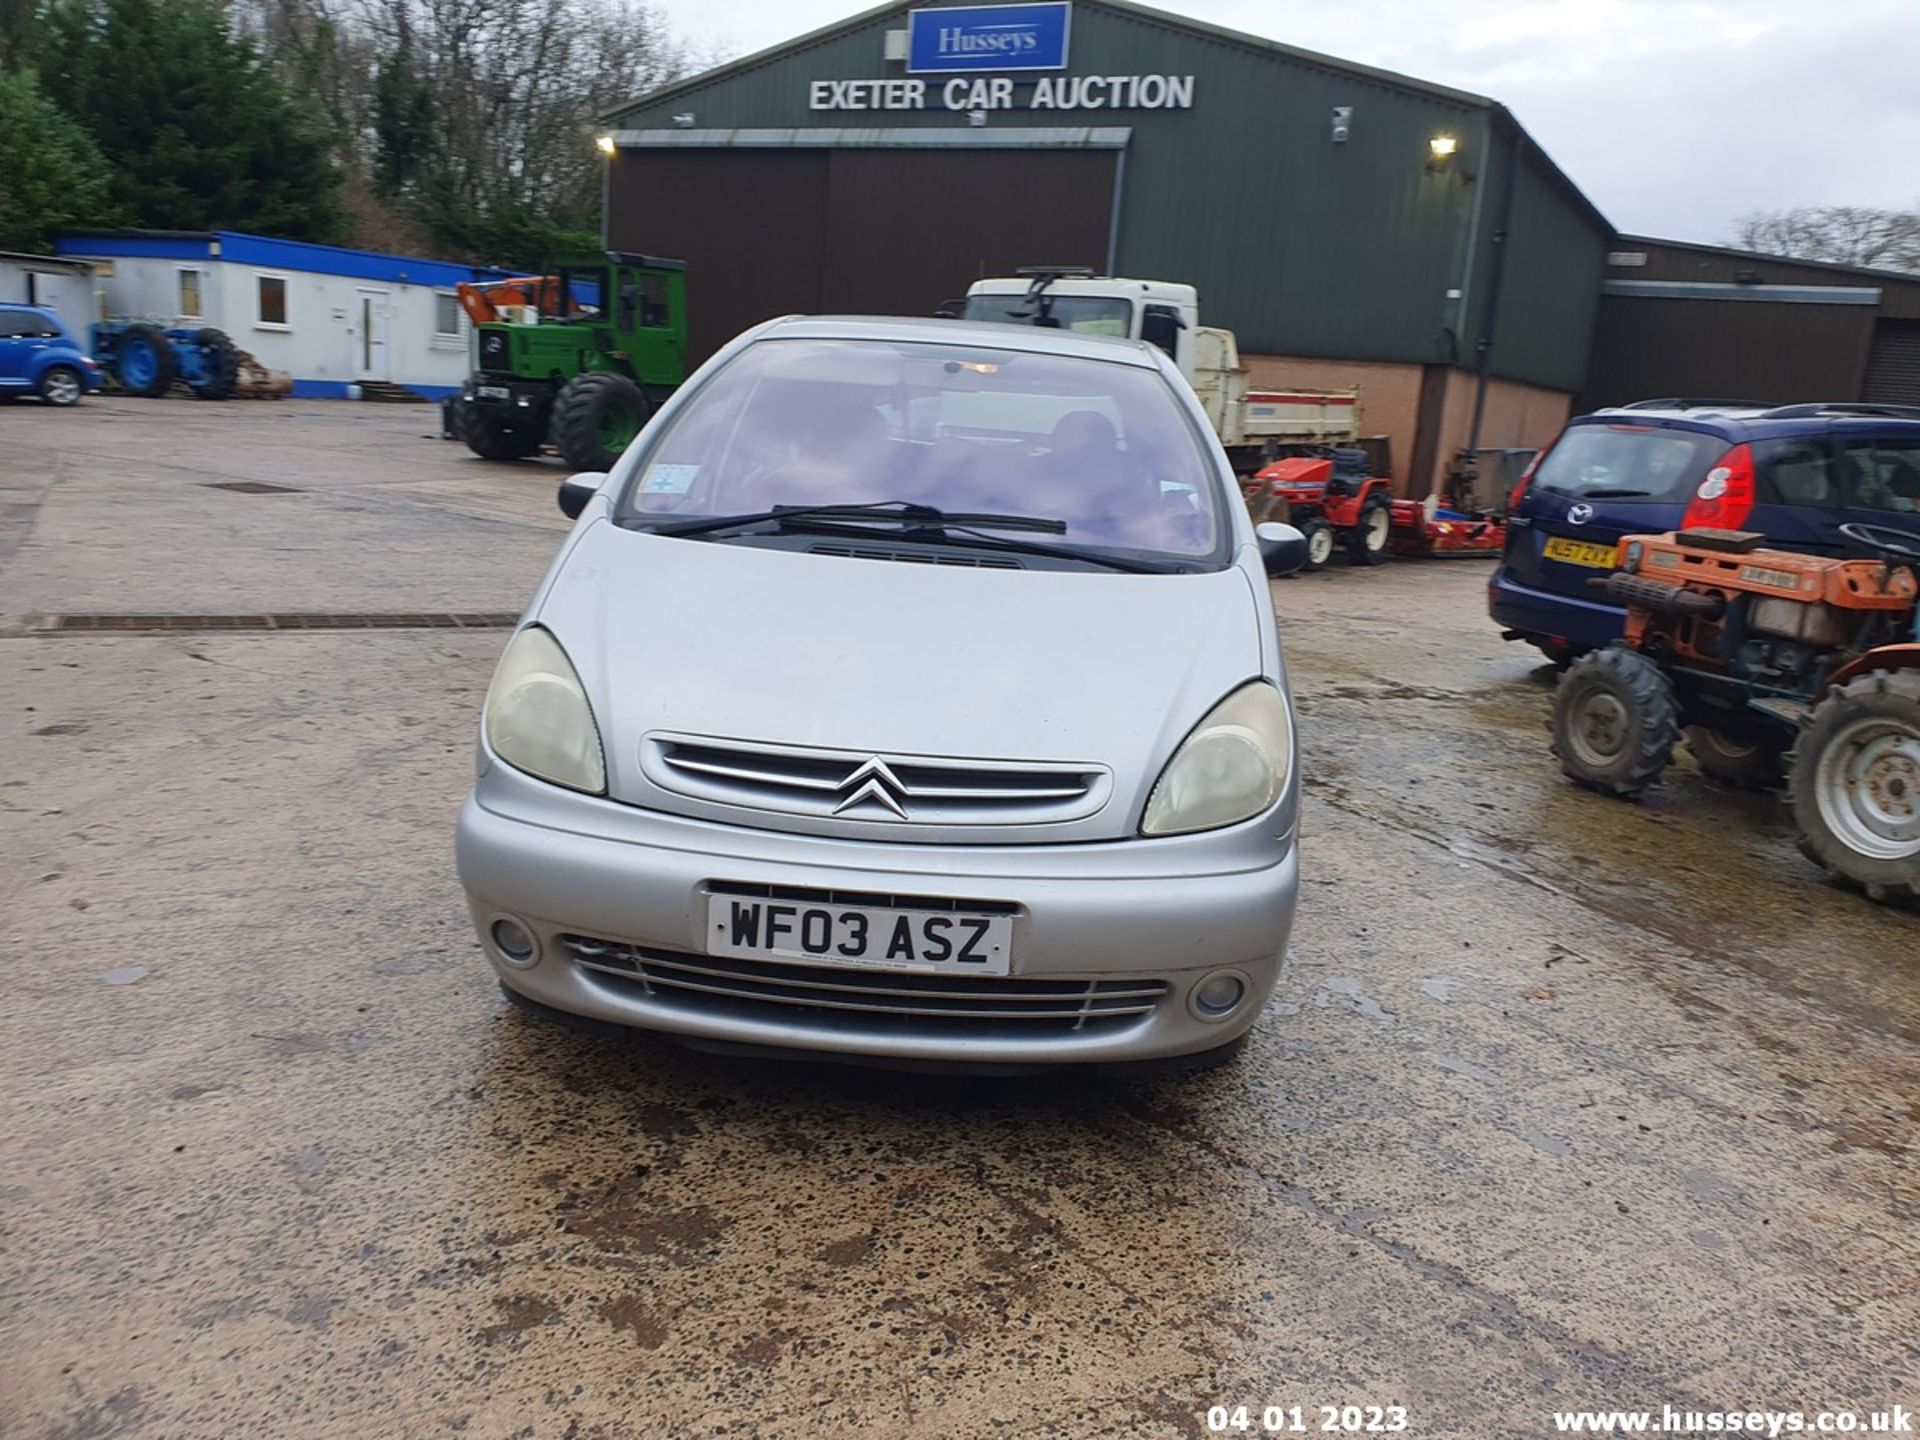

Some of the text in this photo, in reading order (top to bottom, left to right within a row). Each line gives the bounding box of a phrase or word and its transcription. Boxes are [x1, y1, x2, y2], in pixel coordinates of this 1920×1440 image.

[938, 27, 1037, 56] Husseys
[809, 75, 1196, 110] EXETER CAR AUCTION
[731, 901, 991, 964] WF03 ASZ
